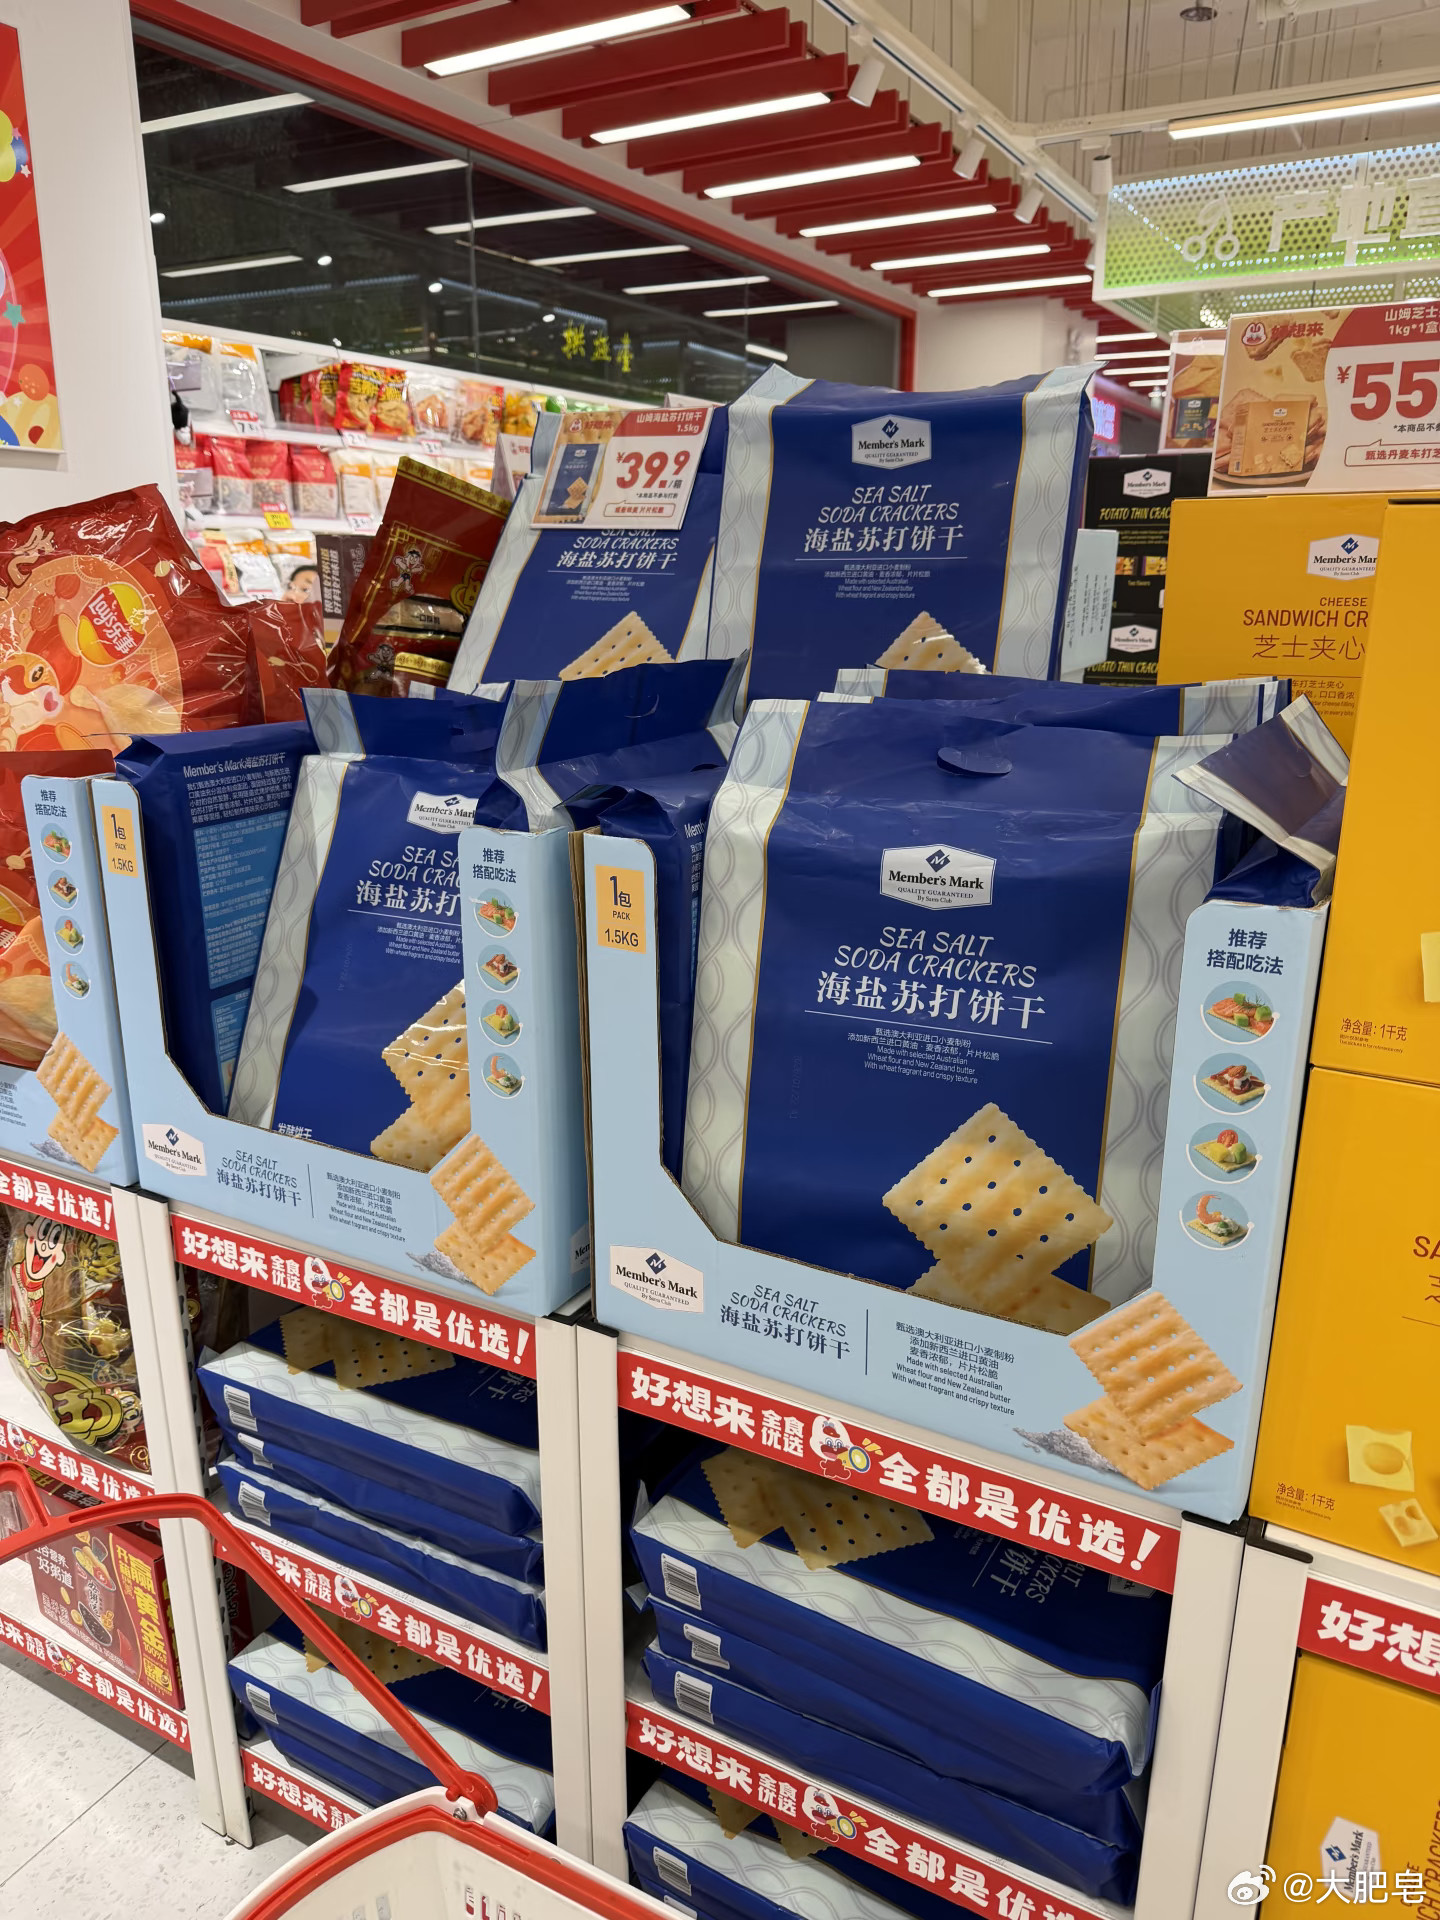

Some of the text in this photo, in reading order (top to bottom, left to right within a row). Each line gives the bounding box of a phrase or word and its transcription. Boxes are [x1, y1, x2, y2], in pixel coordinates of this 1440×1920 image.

[1385, 305, 1440, 322] 山姆芝士
[1270, 321, 1324, 341] 好想来
[636, 411, 703, 424] 山姆海盐苏打饼干
[676, 424, 700, 434] 1.5kg
[858, 437, 925, 450] Member's Mark
[852, 484, 932, 504] SEA SALT
[1152, 480, 1167, 488] Mark
[818, 502, 960, 524] SODA CRACKERS
[1099, 507, 1130, 521] POTATO
[1130, 506, 1148, 520] THIN
[573, 536, 680, 550] SODA CRACKERS
[804, 524, 964, 553] 海盐苏打饼干
[556, 550, 678, 570] 海盐苏打饼干
[1313, 555, 1357, 564] Member's
[1319, 596, 1368, 607] CHEESE
[87, 593, 138, 656] Lay's 乐事
[1242, 609, 1340, 628] SANDWICH
[1251, 634, 1366, 661] 芝士夹心
[183, 761, 224, 779] Member's
[40, 788, 58, 803] 推荐
[35, 803, 68, 819] 搭配吃法
[414, 803, 453, 816] Member's
[114, 842, 127, 851] PACK
[402, 845, 437, 866] SEA
[482, 847, 506, 865] 推荐
[111, 857, 134, 873] 1.5KG
[368, 860, 417, 882] SODA
[472, 863, 518, 884] 搭配吃法
[609, 875, 632, 908] 1包
[888, 869, 985, 890] Member's Mark
[356, 879, 461, 917] 海盐苏打
[897, 886, 974, 899] QUALITY GUARANTEED
[612, 910, 631, 921] PACK
[604, 927, 640, 947] 1.5KG
[879, 926, 995, 958] SEA SALT
[1227, 927, 1268, 950] 推荐
[834, 944, 1038, 989] SODA CRACKERS
[1206, 948, 1284, 976] 搭配吃法
[816, 970, 1047, 1030] 海盐苏打饼干
[875, 1027, 972, 1048] 甄选澳大利亚进口小麦制粉
[147, 1139, 202, 1166] Member's Mark
[235, 1150, 278, 1170] SEA SALT
[221, 1156, 298, 1189] SODA CRACKERS
[216, 1168, 302, 1207] 海盐苏打饼干
[326, 1171, 401, 1200] 甄选澳大利亚进口小麦制粉
[335, 1183, 393, 1206] 添加新西兰进口黄油
[270, 1268, 302, 1293] 优选
[615, 1264, 698, 1299] Member's Mark
[180, 1226, 531, 1366] 好想来 全食 全都是优选！
[623, 1281, 690, 1306] QUALITY GUARANTEED
[753, 1284, 819, 1314] SEA SALT
[730, 1291, 847, 1337] SODA CRACKERS
[720, 1304, 850, 1360] 海盐苏打饼干
[895, 1321, 1015, 1364] 甄选澳大利亚进口小麦制粉
[909, 1335, 1000, 1370] 添加新西兰进口黄油
[896, 1362, 1011, 1404] Wheat flour and New Zealand butter
[906, 1355, 1003, 1391] Made with selected Australian
[892, 1371, 1015, 1416] With wheat fragrant and crispy texture
[760, 1426, 804, 1458] 优选
[630, 1365, 1162, 1572] 好想来 全食 全都是优选！
[37, 1555, 74, 1590] 好粥道
[304, 1579, 332, 1604] 优选
[376, 1603, 544, 1701] 全都是优选！
[75, 1663, 189, 1744] 全都是优选！
[638, 1717, 753, 1796] 好想来
[757, 1772, 798, 1801] 全食
[251, 1761, 328, 1823] 好想来
[757, 1785, 798, 1818] 优选
